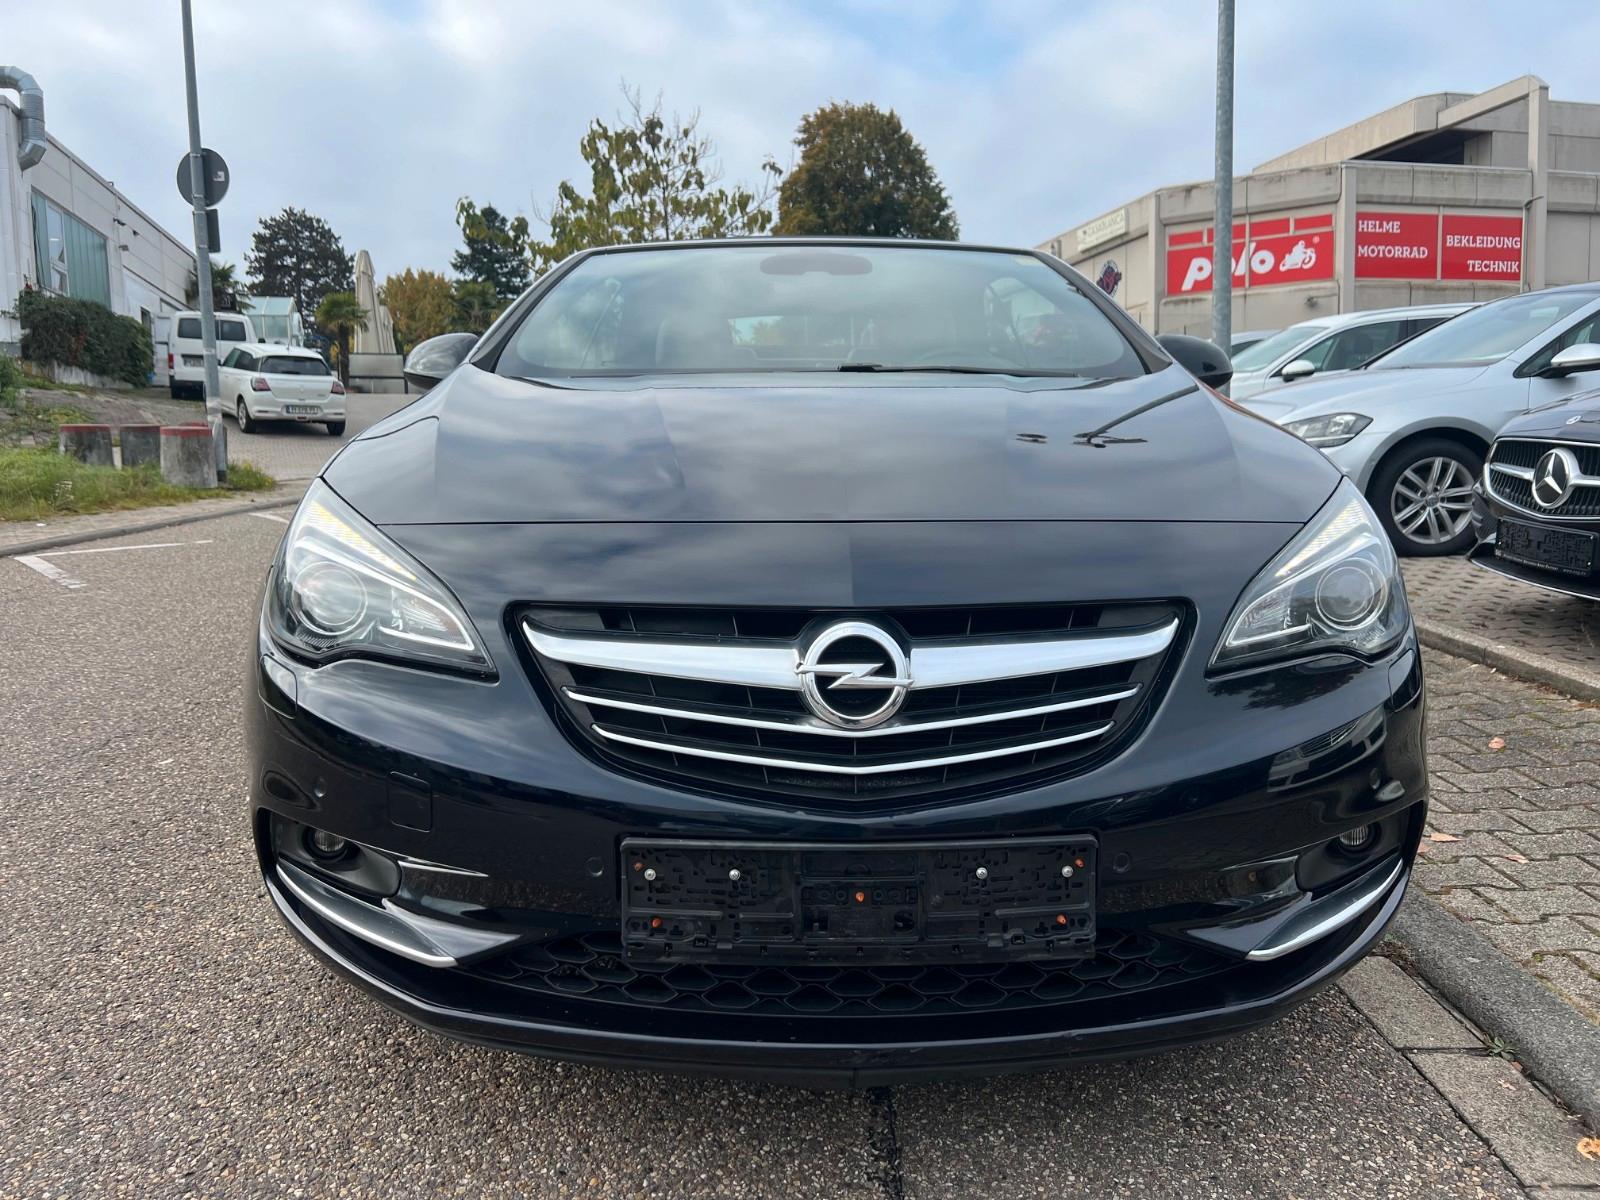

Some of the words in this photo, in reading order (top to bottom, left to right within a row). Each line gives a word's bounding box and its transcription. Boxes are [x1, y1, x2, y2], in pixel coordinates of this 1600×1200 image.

[1358, 220, 1401, 233] HELME
[1446, 235, 1521, 248] BEKLEIDUNG
[1358, 245, 1428, 259] MOTORRAD
[1181, 242, 1275, 291] plo
[1467, 260, 1519, 272] TECHNIK
